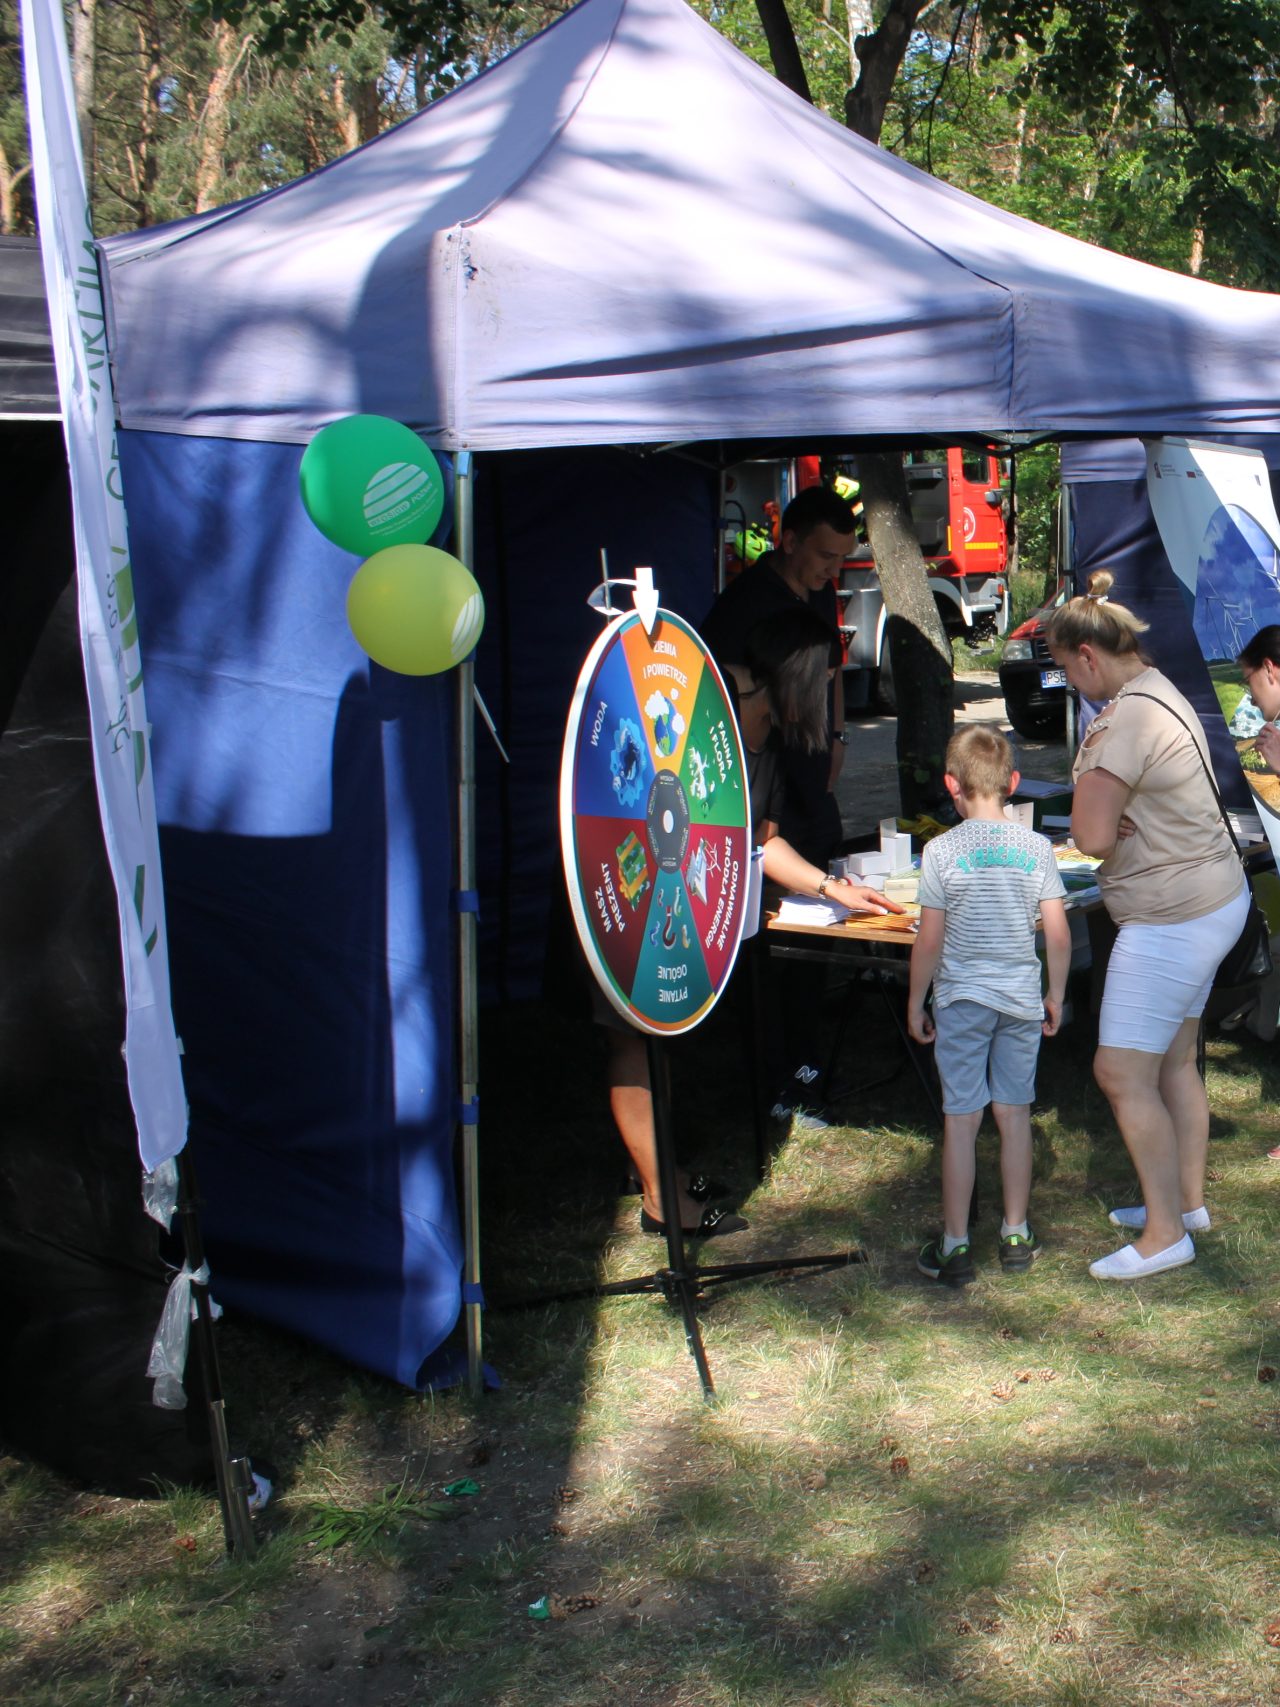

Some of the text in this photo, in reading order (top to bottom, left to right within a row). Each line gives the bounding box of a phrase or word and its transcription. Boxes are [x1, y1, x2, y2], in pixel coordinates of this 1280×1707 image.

[653, 640, 677, 658] ZIEMIA
[647, 663, 688, 688] POWIETRZE
[590, 701, 608, 747] WODA
[717, 720, 733, 770] FAUNA
[711, 734, 726, 784] FLORA
[594, 886, 612, 933] MASZ
[601, 862, 626, 933] PREZENT
[718, 860, 739, 951] ODNAWIALNE
[705, 897, 725, 949] ENERGII
[657, 964, 688, 982] OGÓLNE
[658, 986, 688, 1003] PYTANIE
